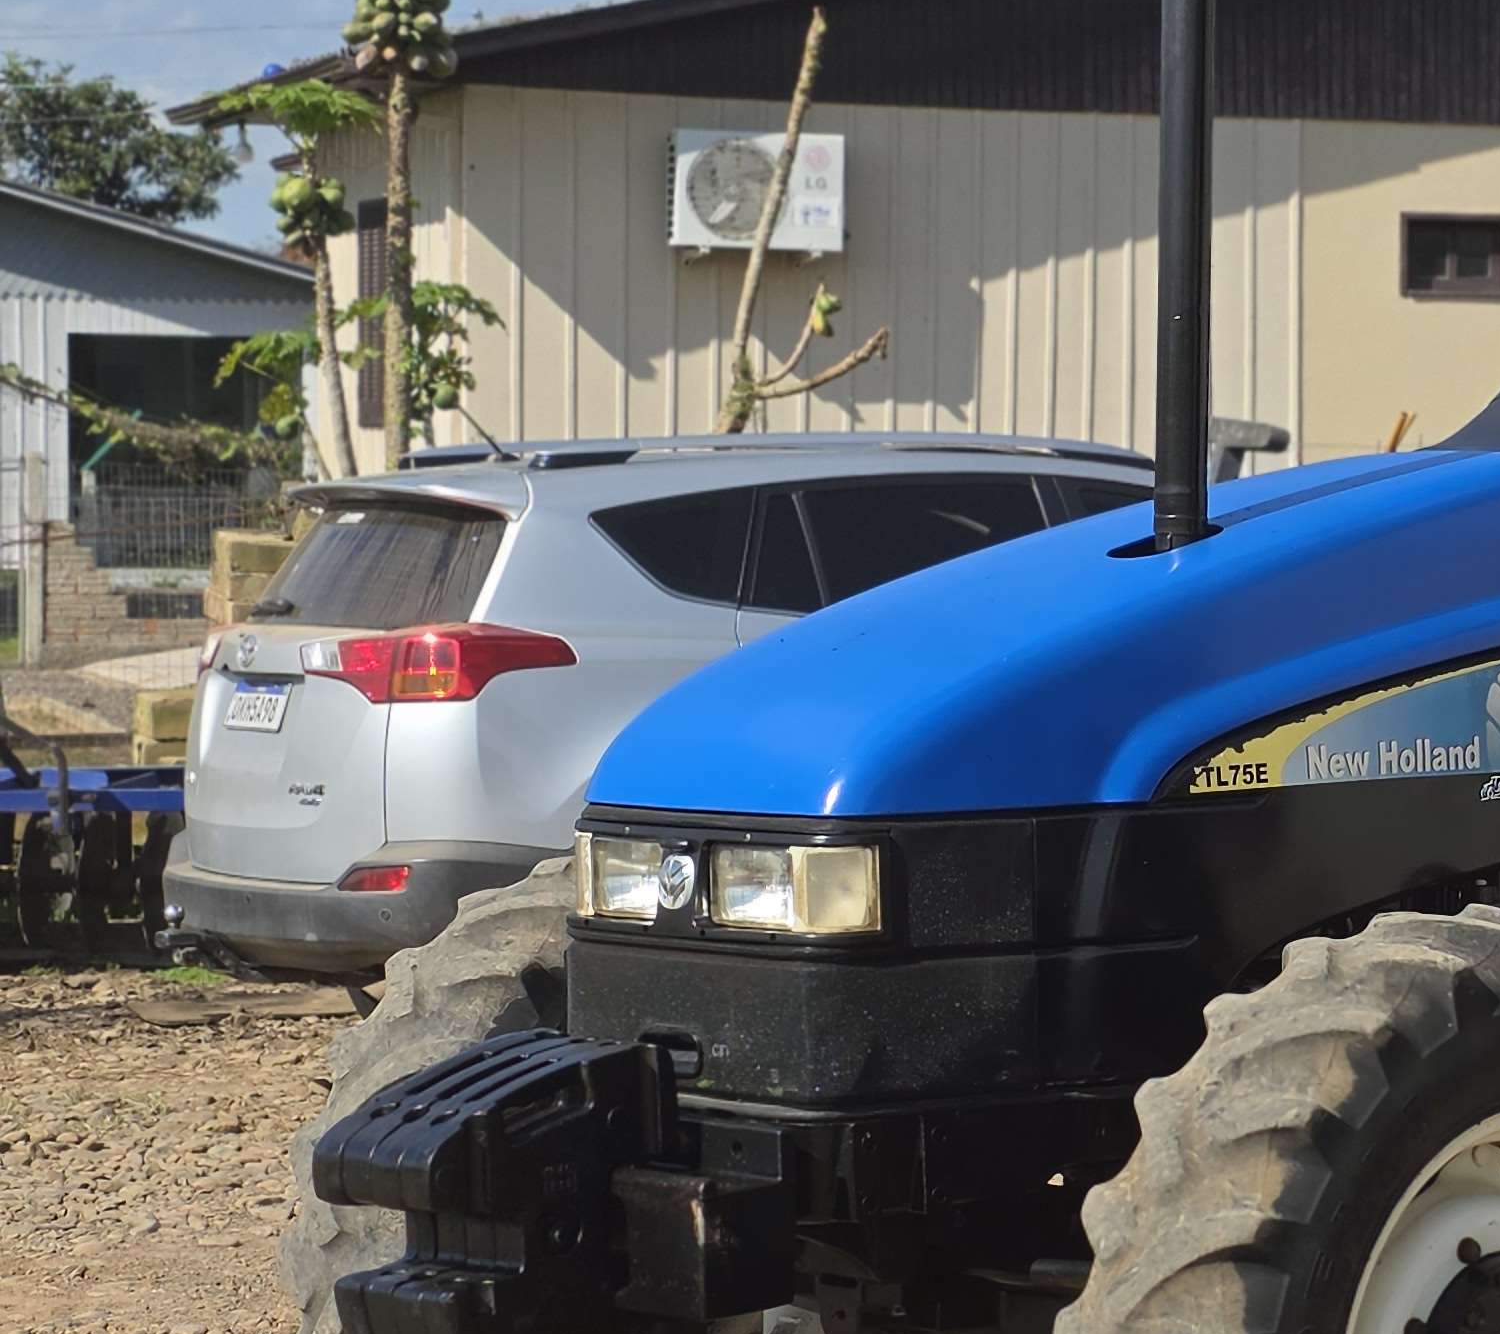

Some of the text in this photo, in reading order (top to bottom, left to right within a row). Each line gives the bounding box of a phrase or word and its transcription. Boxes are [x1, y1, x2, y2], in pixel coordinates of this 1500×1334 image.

[805, 176, 828, 190] LG
[1305, 734, 1481, 780] New Holland
[1201, 762, 1269, 788] TL75E
